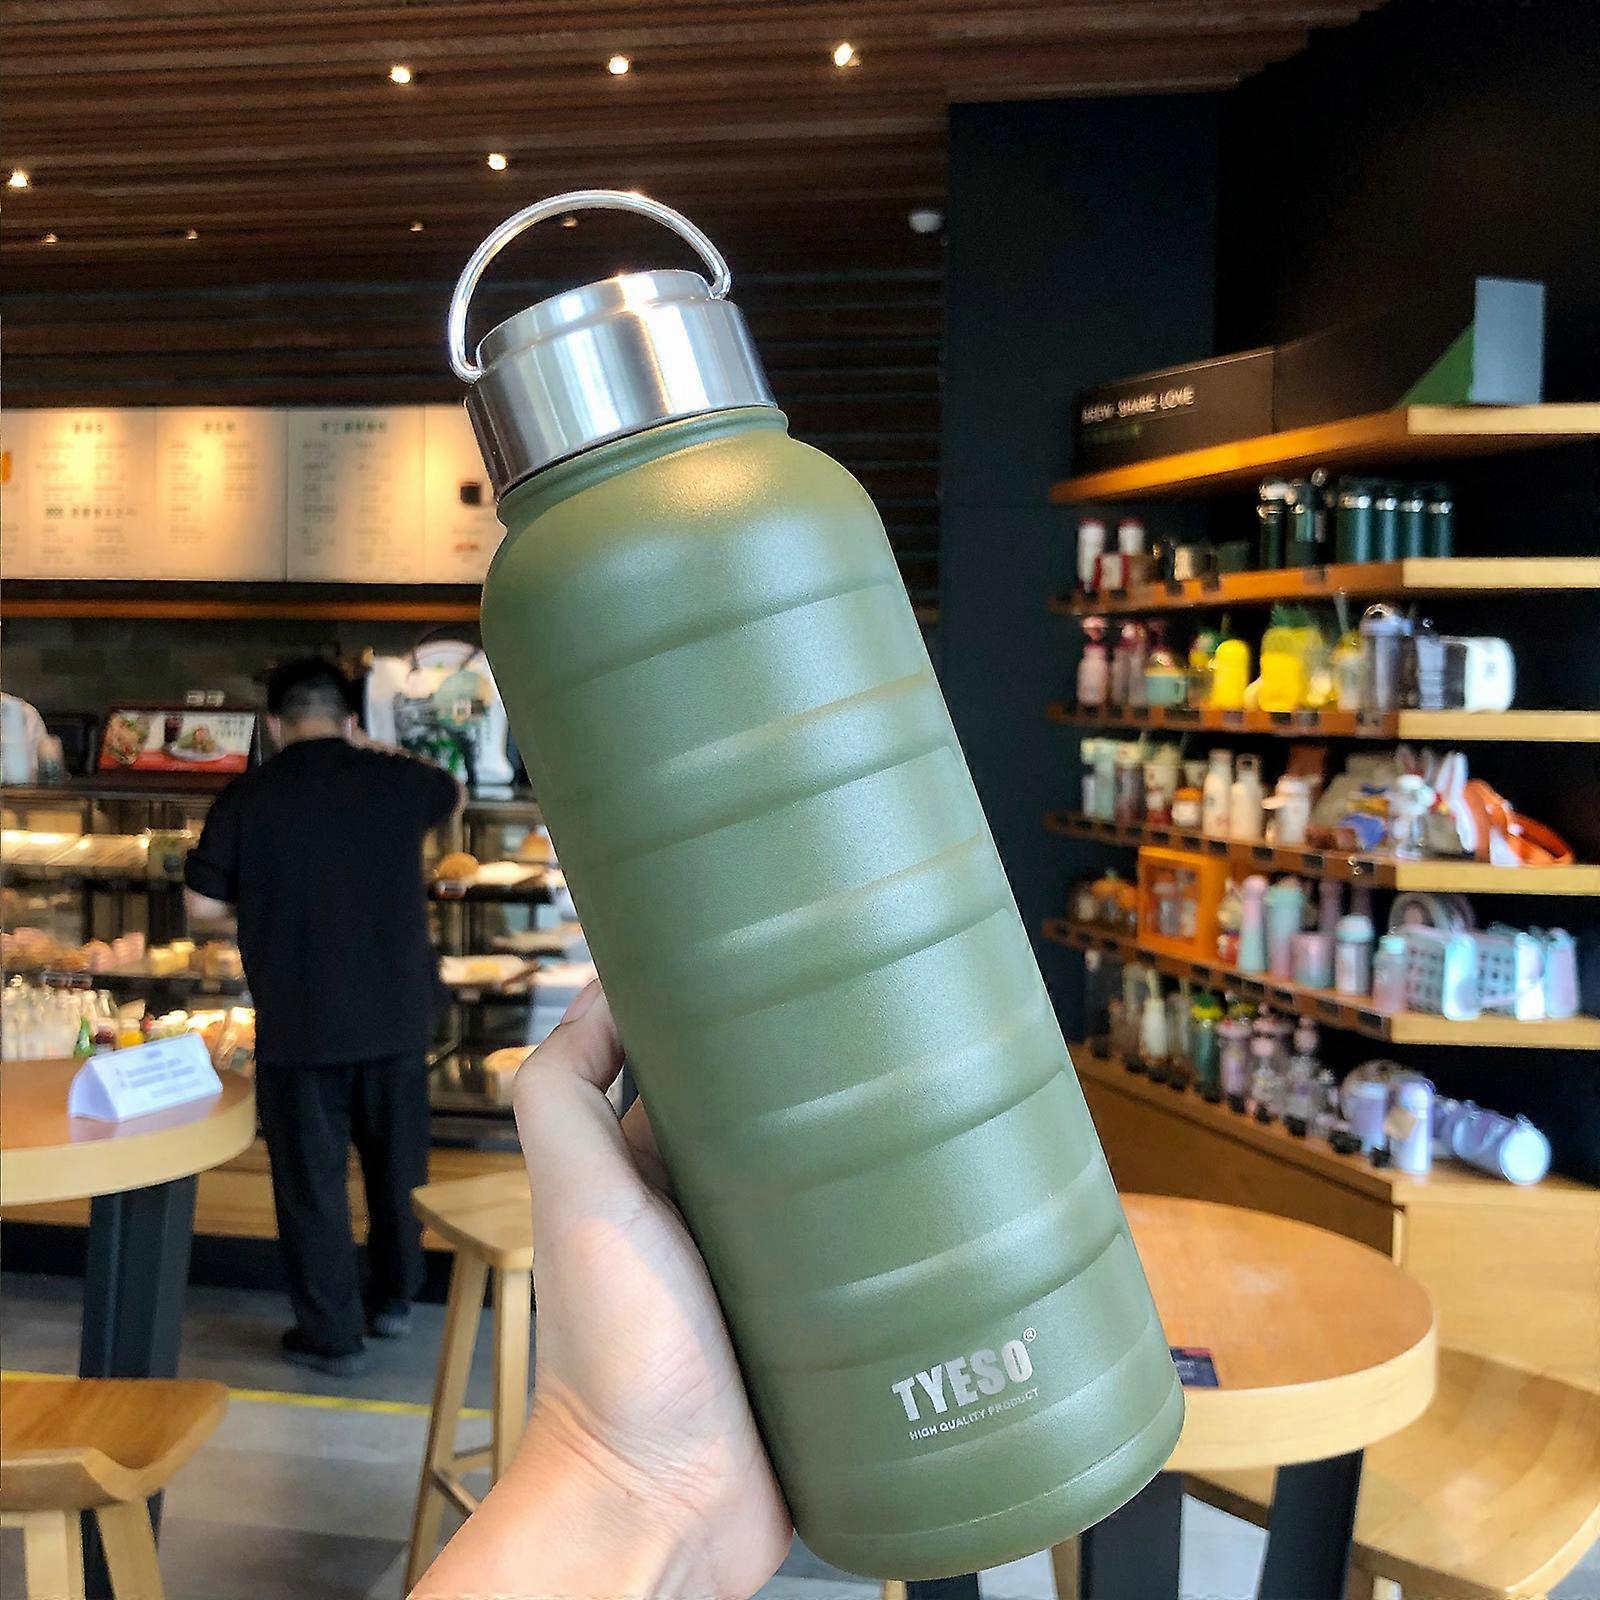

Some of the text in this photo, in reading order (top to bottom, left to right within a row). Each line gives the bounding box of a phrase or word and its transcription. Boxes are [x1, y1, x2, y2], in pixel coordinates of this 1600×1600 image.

[1160, 385, 1195, 410] LOVE
[909, 1387, 1039, 1441] HIGH QUALITY PRODUCT
